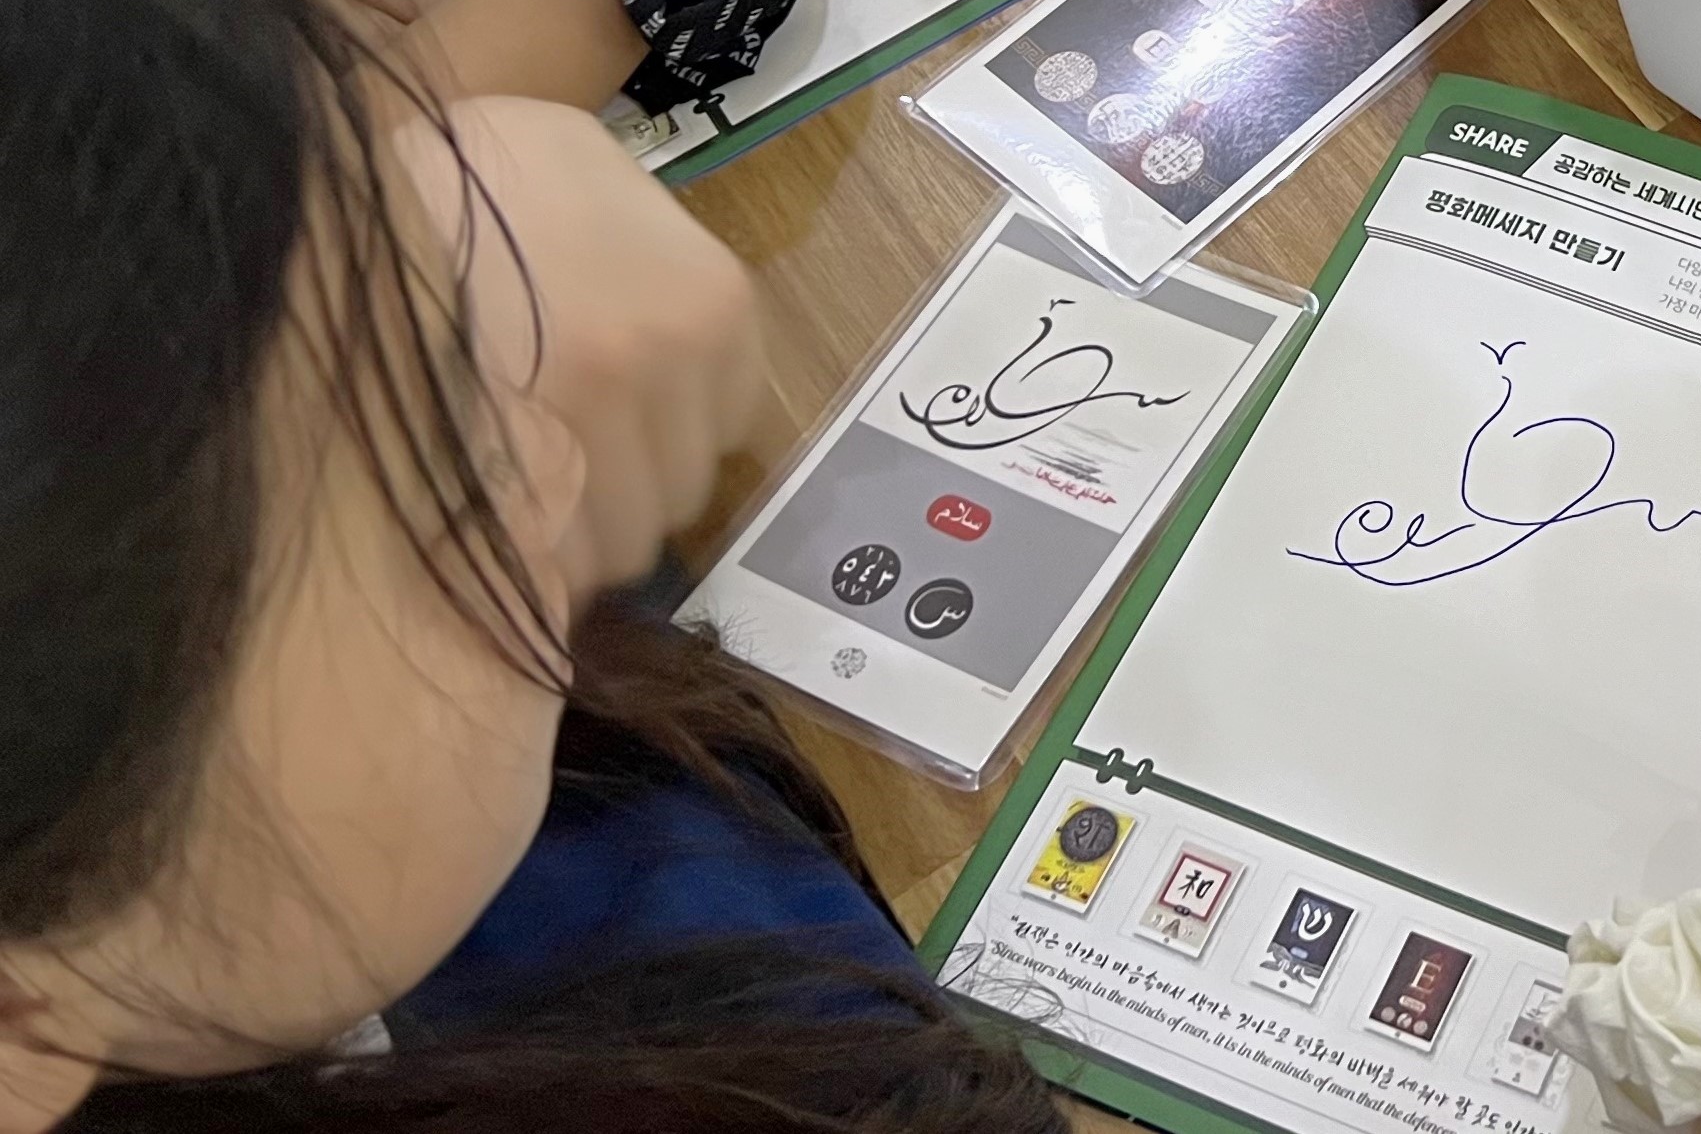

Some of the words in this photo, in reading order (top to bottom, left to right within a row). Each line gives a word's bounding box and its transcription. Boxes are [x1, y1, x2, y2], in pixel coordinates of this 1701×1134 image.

[1450, 123, 1529, 157] SHARE
[1554, 154, 1630, 194] 공감하는
[1426, 190, 1547, 244] 평화메세지
[1549, 230, 1625, 271] 만들기
[1659, 294, 1687, 313] 가장
[1669, 275, 1697, 294] 나의
[932, 493, 990, 539] سلام
[1182, 868, 1215, 901] 和
[1065, 942, 1109, 969] 인간의
[1188, 992, 1231, 1020] 생기는
[1053, 966, 1094, 997] begin
[1089, 980, 1110, 1001] in
[1105, 986, 1130, 1009] the
[1123, 993, 1168, 1025] minds
[1162, 1009, 1187, 1036] of
[1251, 1046, 1276, 1071] the
[1270, 1055, 1316, 1085] minds
[1311, 1072, 1332, 1096] of
[1328, 1080, 1357, 1102] men
[1354, 1090, 1385, 1113] that
[1381, 1100, 1405, 1121] the
